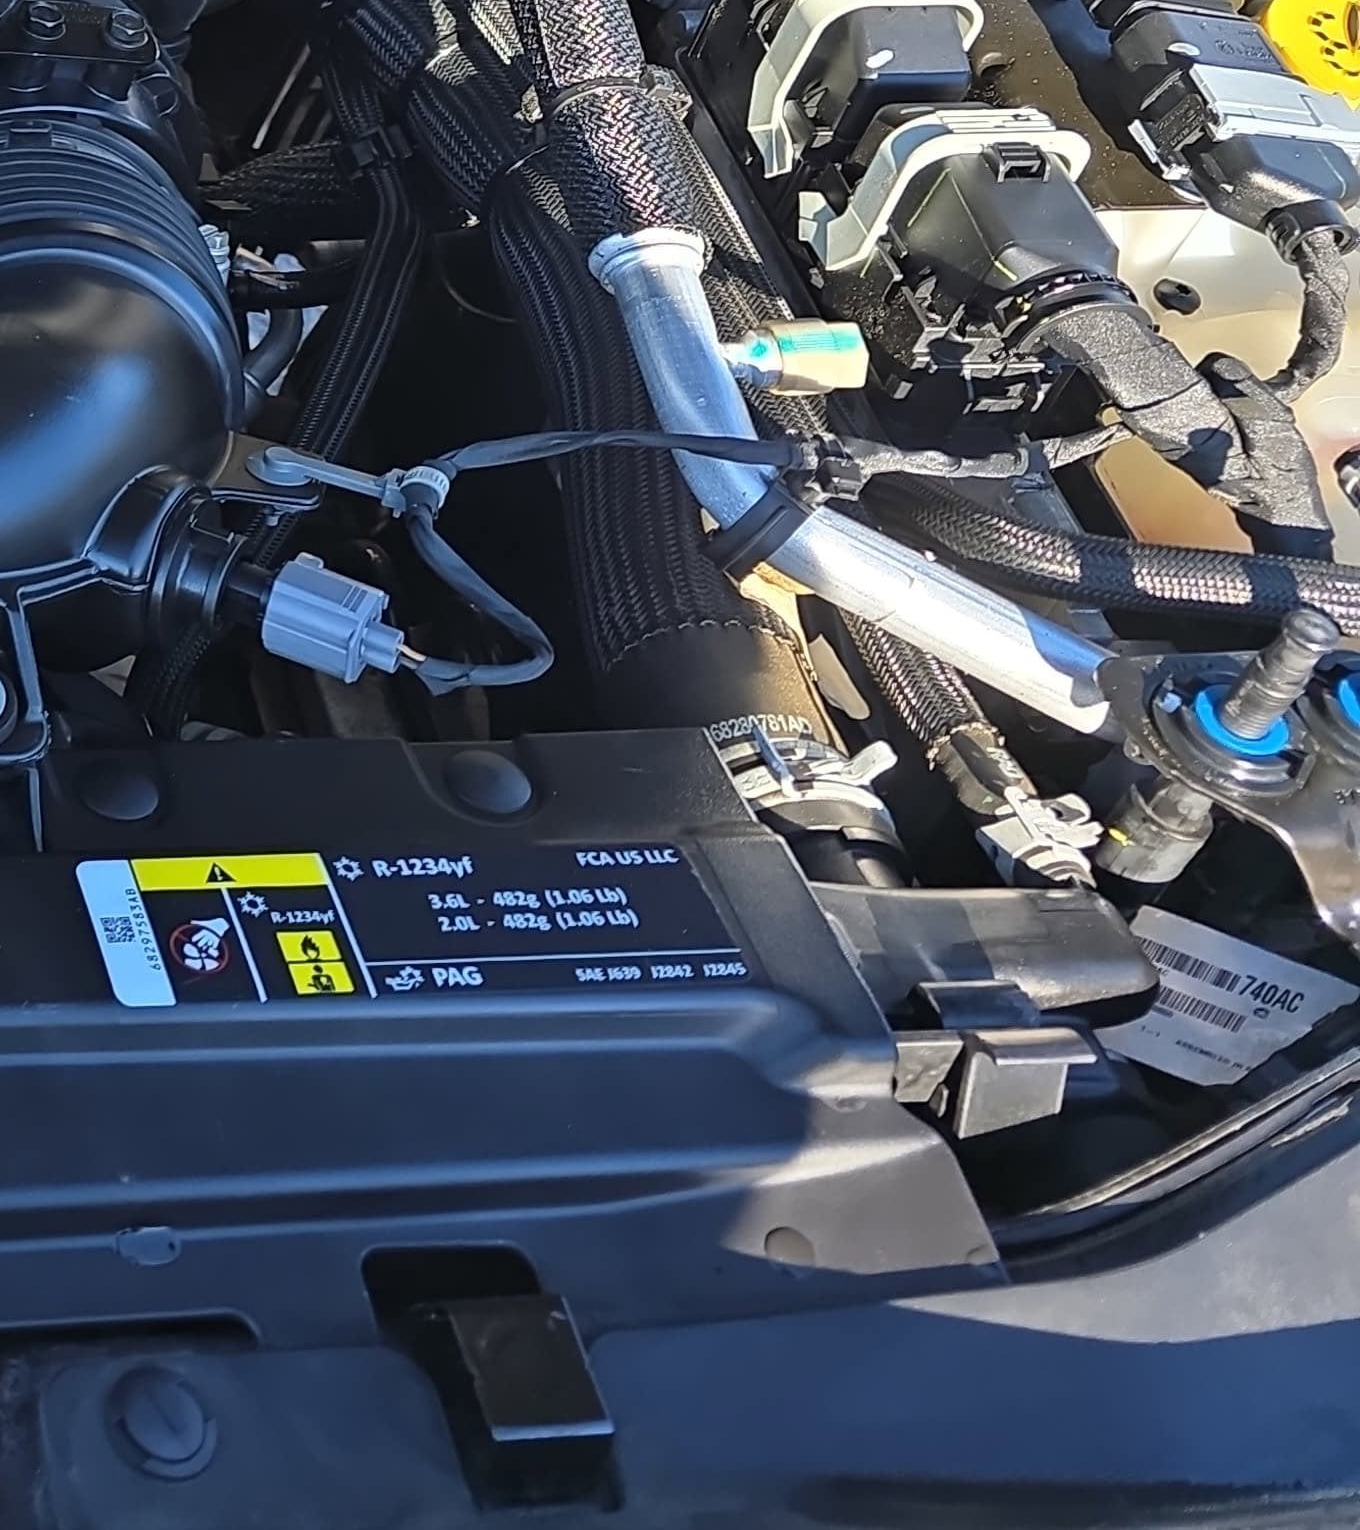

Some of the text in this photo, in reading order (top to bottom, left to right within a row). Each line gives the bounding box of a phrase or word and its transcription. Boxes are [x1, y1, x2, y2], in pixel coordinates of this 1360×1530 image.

[371, 855, 473, 878] R-1234yf
[576, 848, 680, 867] FCA US LLC
[428, 893, 470, 909] 3.6L
[493, 891, 541, 909] 482g
[545, 889, 594, 908] (1.06
[594, 887, 628, 906] Lb)
[270, 908, 336, 925] R-1234yf
[437, 915, 480, 932] 2.0L
[503, 913, 551, 931] 482g
[555, 911, 605, 930] (1.06
[605, 909, 639, 928] Lb)
[431, 965, 483, 987] PAG
[575, 967, 606, 982] SAE
[1238, 975, 1304, 1013] 740AC
